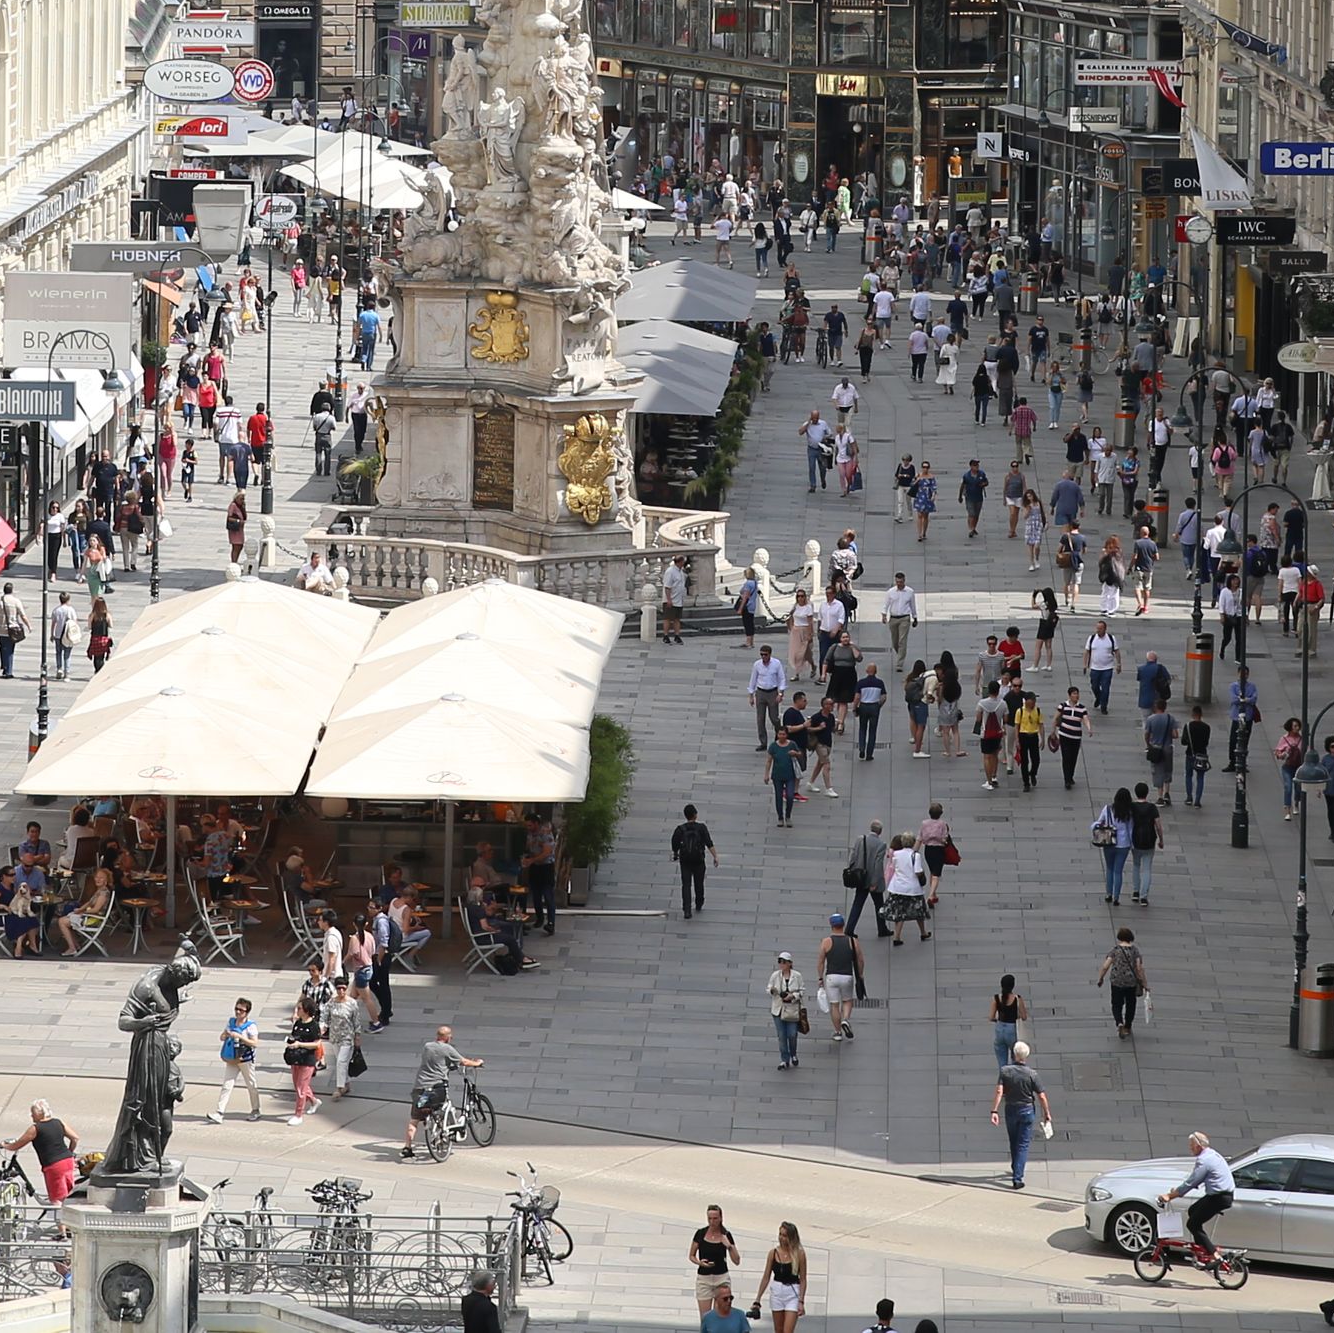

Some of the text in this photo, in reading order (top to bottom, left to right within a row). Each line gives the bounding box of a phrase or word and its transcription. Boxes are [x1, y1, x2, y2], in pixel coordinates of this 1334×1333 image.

[273, 7, 301, 15] OMEGA
[157, 70, 221, 83] WORSEG
[1095, 165, 1114, 182] FOSSIL
[1206, 190, 1252, 202] LISKA
[1238, 221, 1266, 234] IWC
[111, 249, 181, 262] HÜBNER
[1281, 257, 1311, 266] BALLY
[27, 288, 107, 299] wienerin
[23, 330, 110, 351] BRAMO
